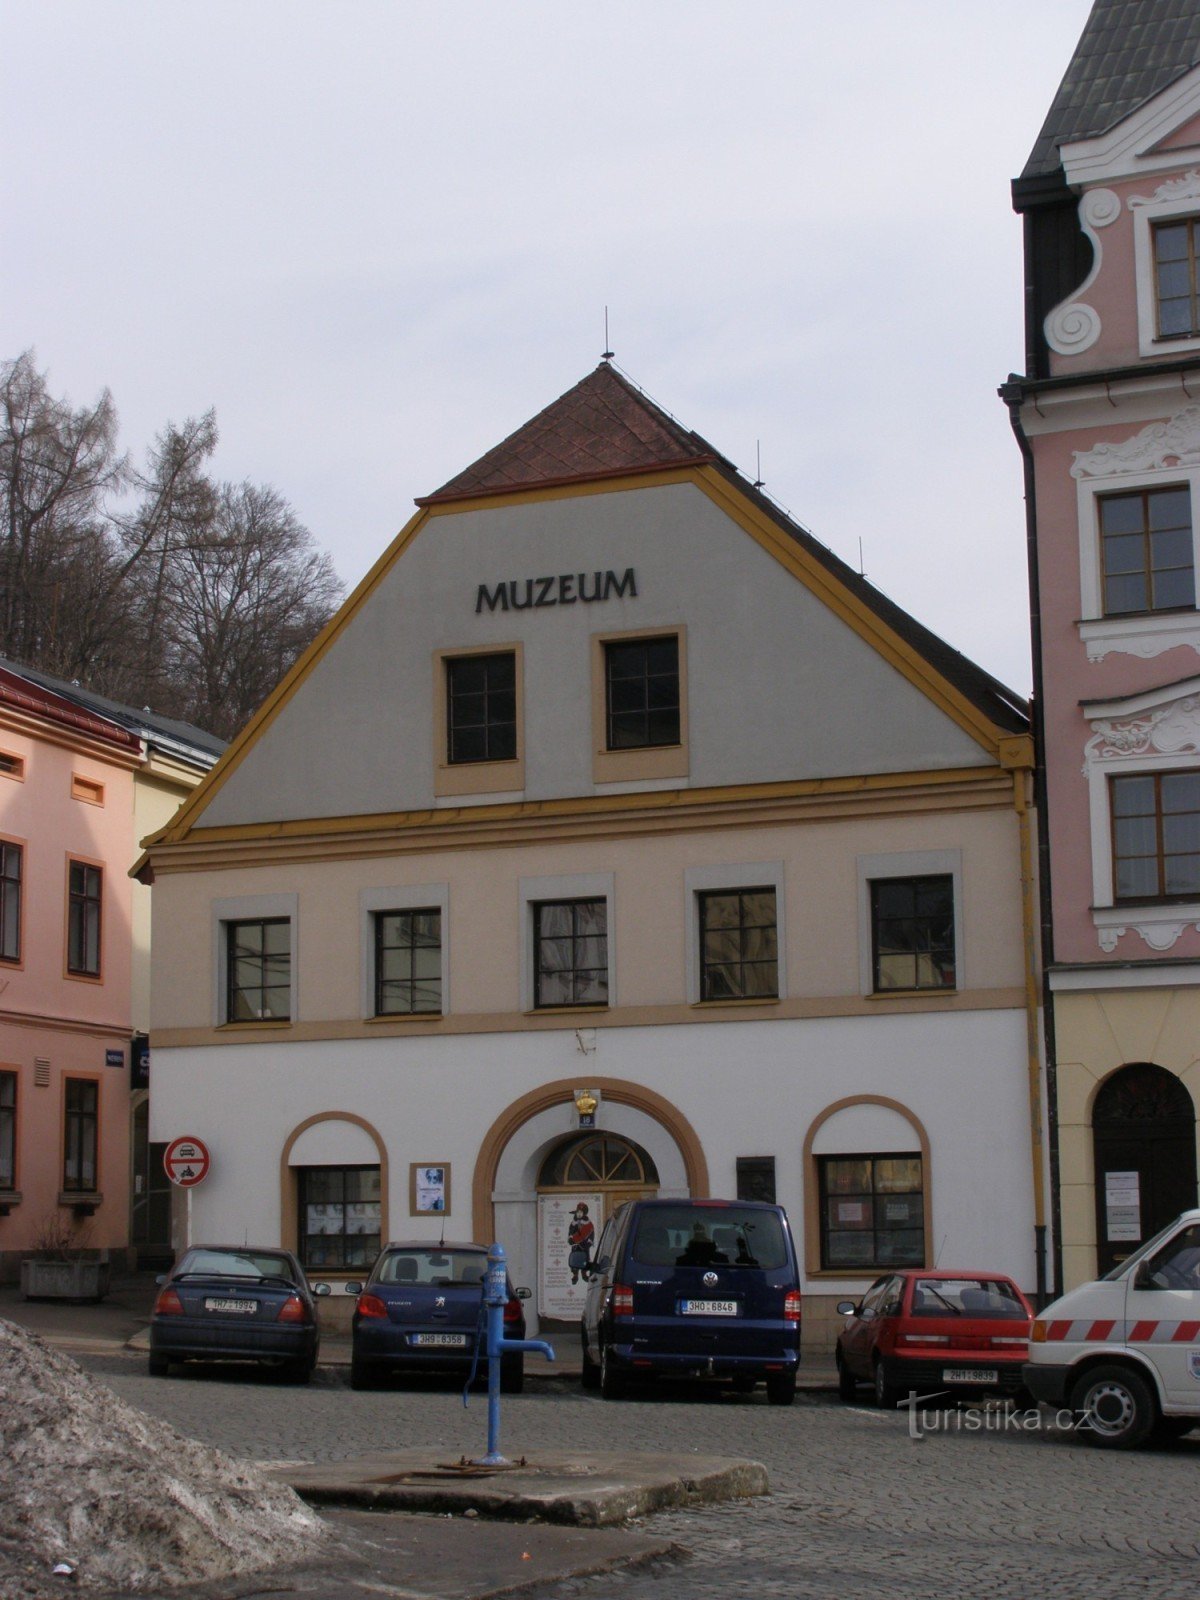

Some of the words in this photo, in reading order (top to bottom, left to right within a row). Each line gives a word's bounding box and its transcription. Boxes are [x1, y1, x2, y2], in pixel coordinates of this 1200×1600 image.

[475, 568, 638, 613] MUZEUM
[689, 1301, 705, 1311] 3H0
[711, 1302, 733, 1312] 6846
[950, 1370, 966, 1380] 2H1
